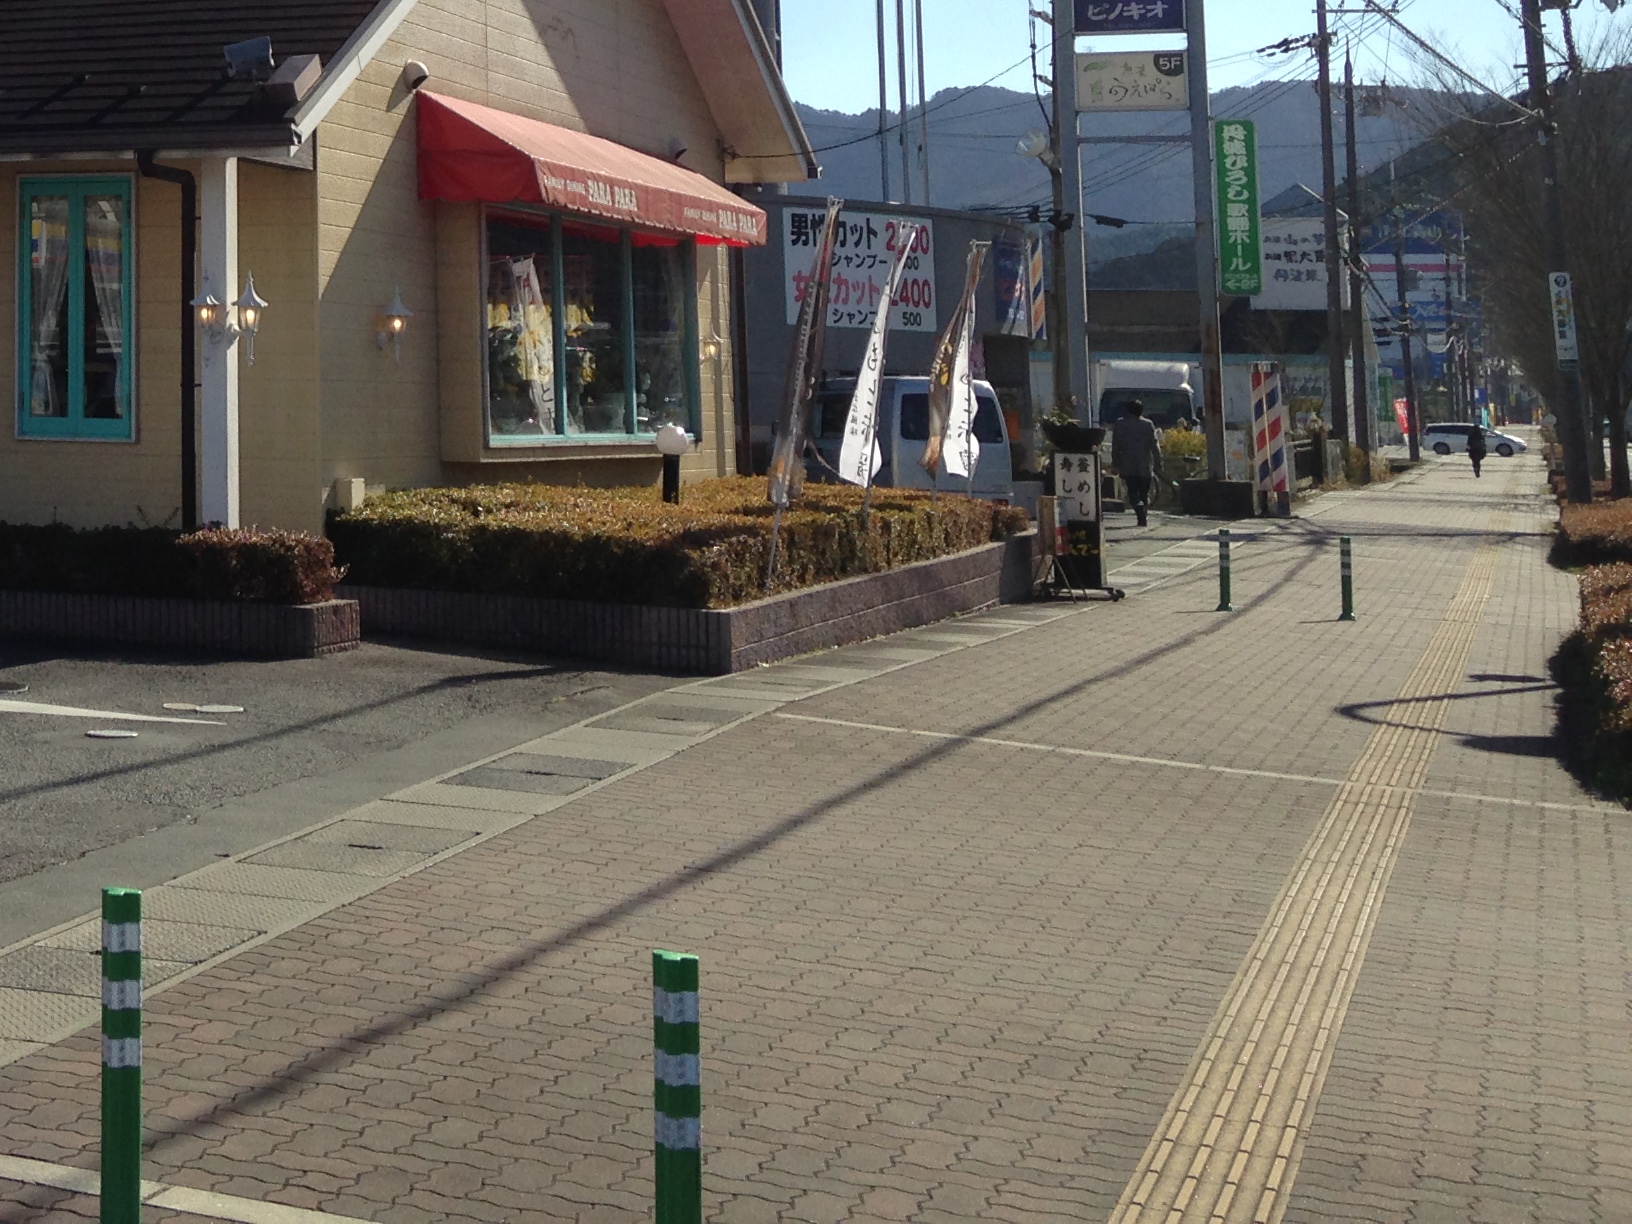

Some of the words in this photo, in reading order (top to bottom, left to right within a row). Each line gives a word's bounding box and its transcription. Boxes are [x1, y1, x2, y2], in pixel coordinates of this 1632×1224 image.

[1088, 0, 1169, 21] ピノキオ
[1159, 57, 1181, 70] 5F
[588, 179, 612, 205] PARA
[615, 186, 637, 211] PARA
[832, 252, 888, 269] シャンプー
[792, 270, 880, 306] 女カット
[902, 311, 922, 326] 500
